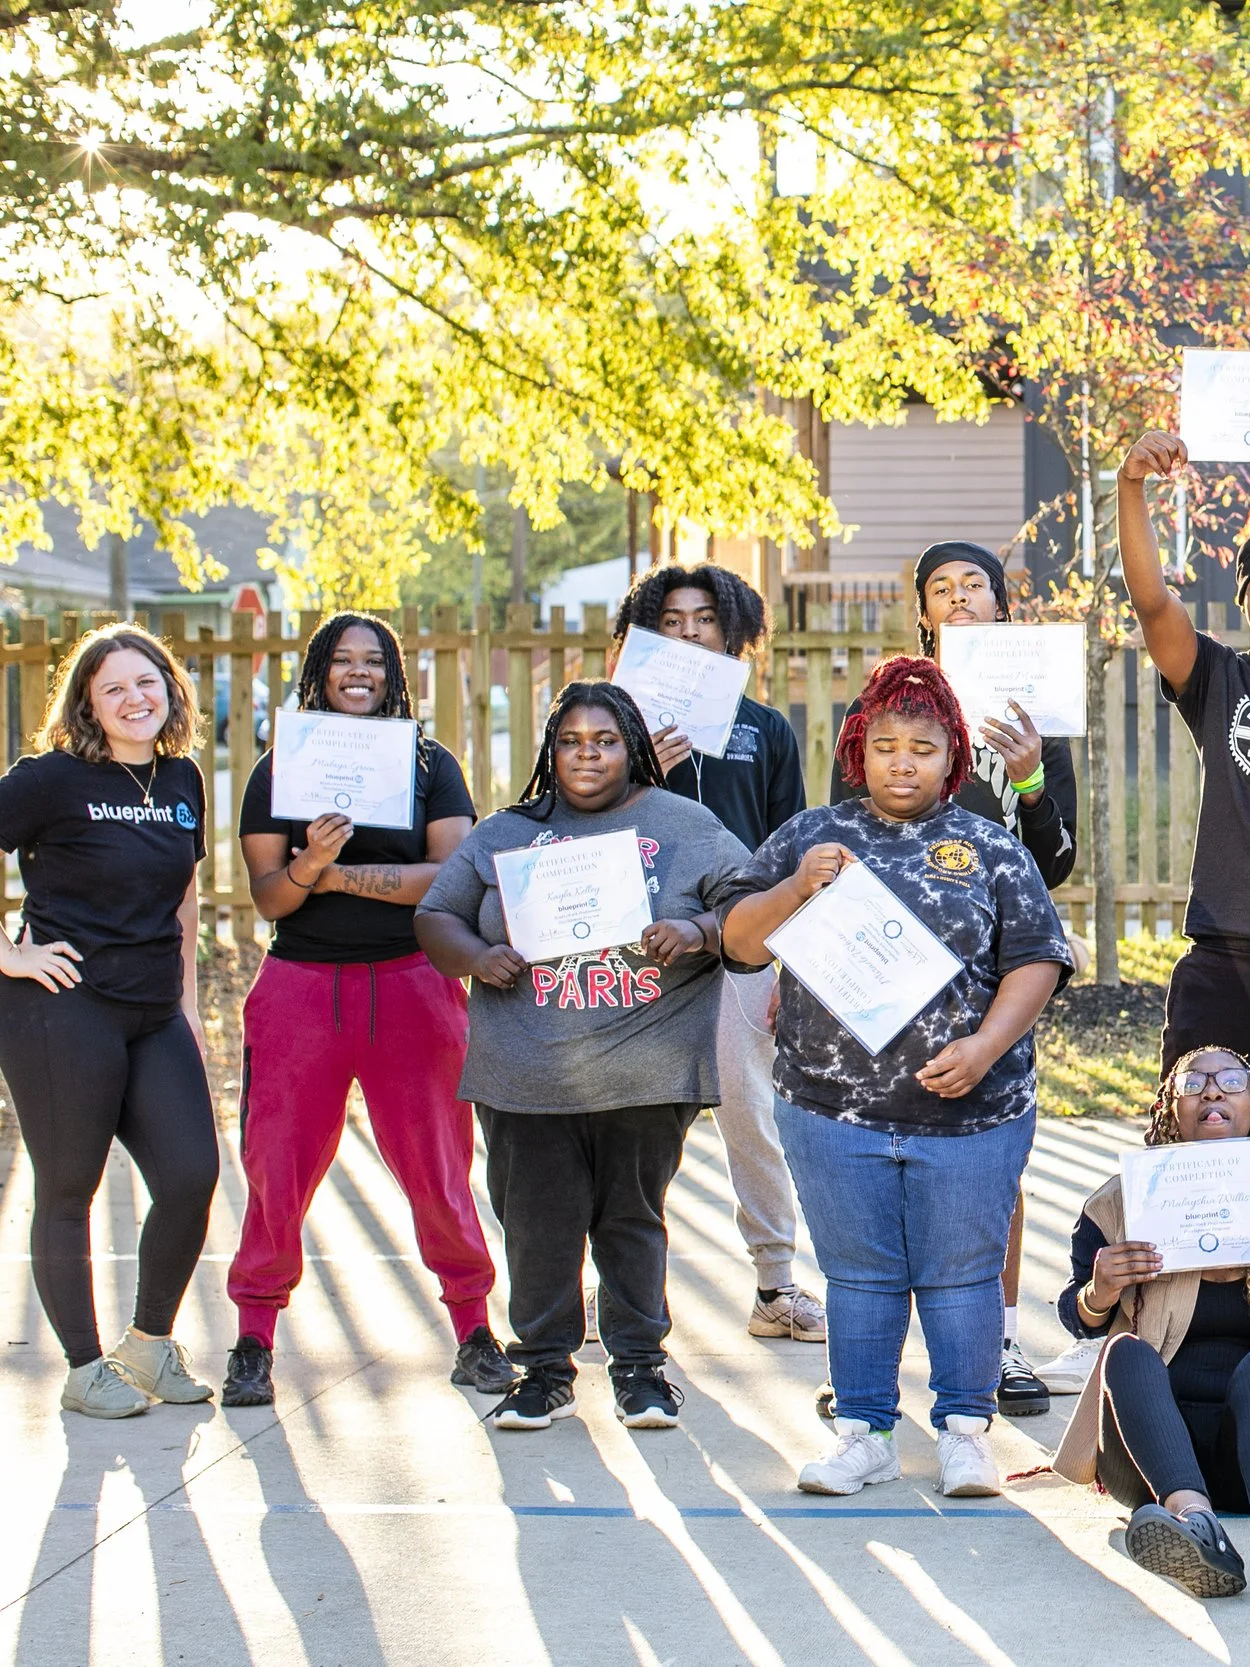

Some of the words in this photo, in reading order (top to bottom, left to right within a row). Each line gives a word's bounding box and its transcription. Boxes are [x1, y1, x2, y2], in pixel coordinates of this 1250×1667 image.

[994, 685, 1024, 693] blueprint
[326, 773, 355, 783] blueprint
[87, 802, 174, 824] blueprint
[525, 853, 585, 870] CERTIFICATE
[591, 849, 603, 858] OF
[536, 862, 597, 880] COMPLETION
[558, 901, 588, 912] blueprint
[864, 938, 889, 966] blueprint
[532, 965, 662, 1009] PARIS
[1156, 1159, 1224, 1173] CERTIFICATE
[1227, 1157, 1241, 1166] OF
[1165, 1169, 1233, 1183] COMPLETION
[1185, 1210, 1219, 1220] blueprint
